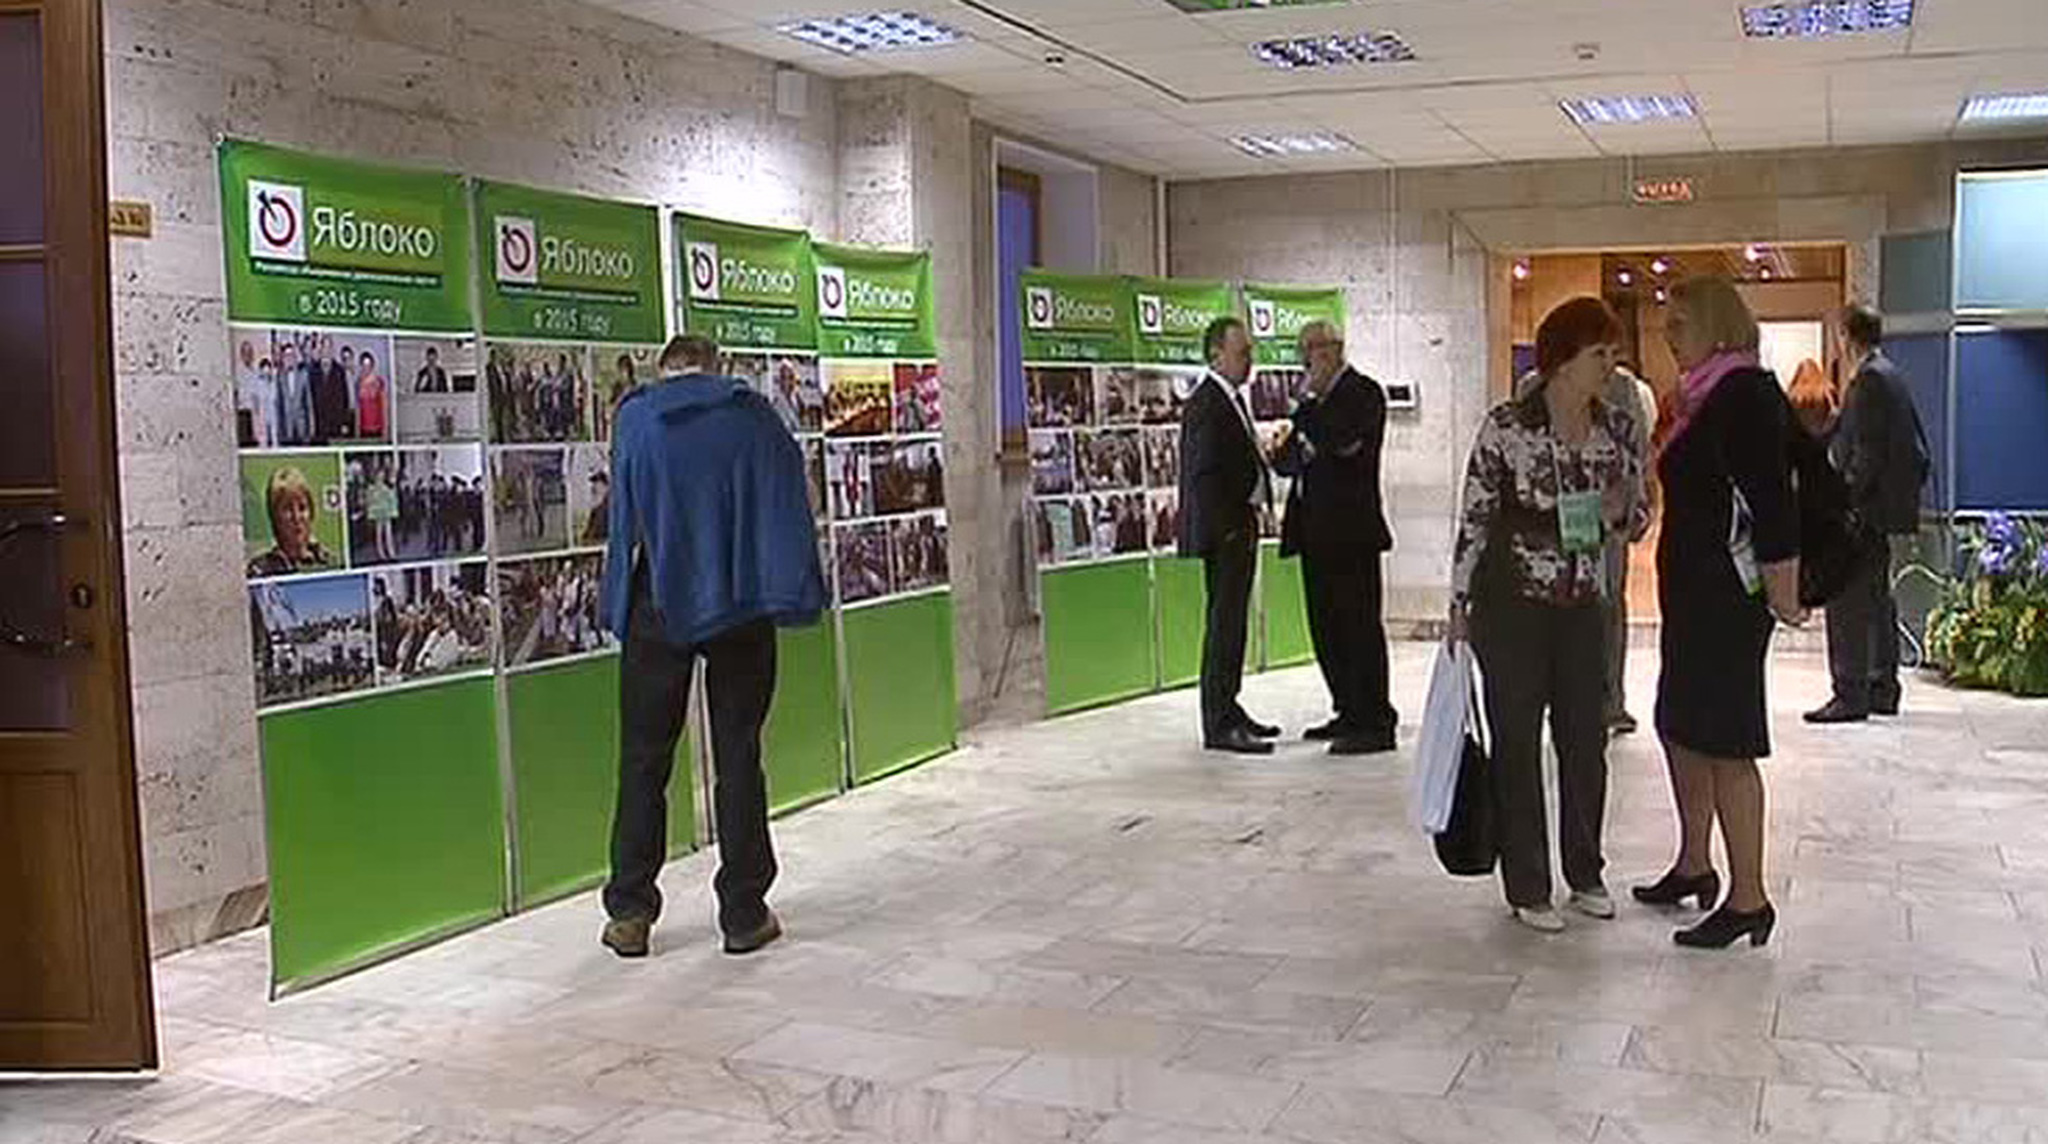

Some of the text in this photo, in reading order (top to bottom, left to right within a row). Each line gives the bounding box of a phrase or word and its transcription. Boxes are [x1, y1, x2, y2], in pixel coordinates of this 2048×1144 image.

[312, 206, 436, 258] Яблоко
[541, 235, 634, 279] Яблоко
[721, 258, 796, 294] Яблоко
[316, 290, 361, 317] 2015
[363, 297, 401, 325] году
